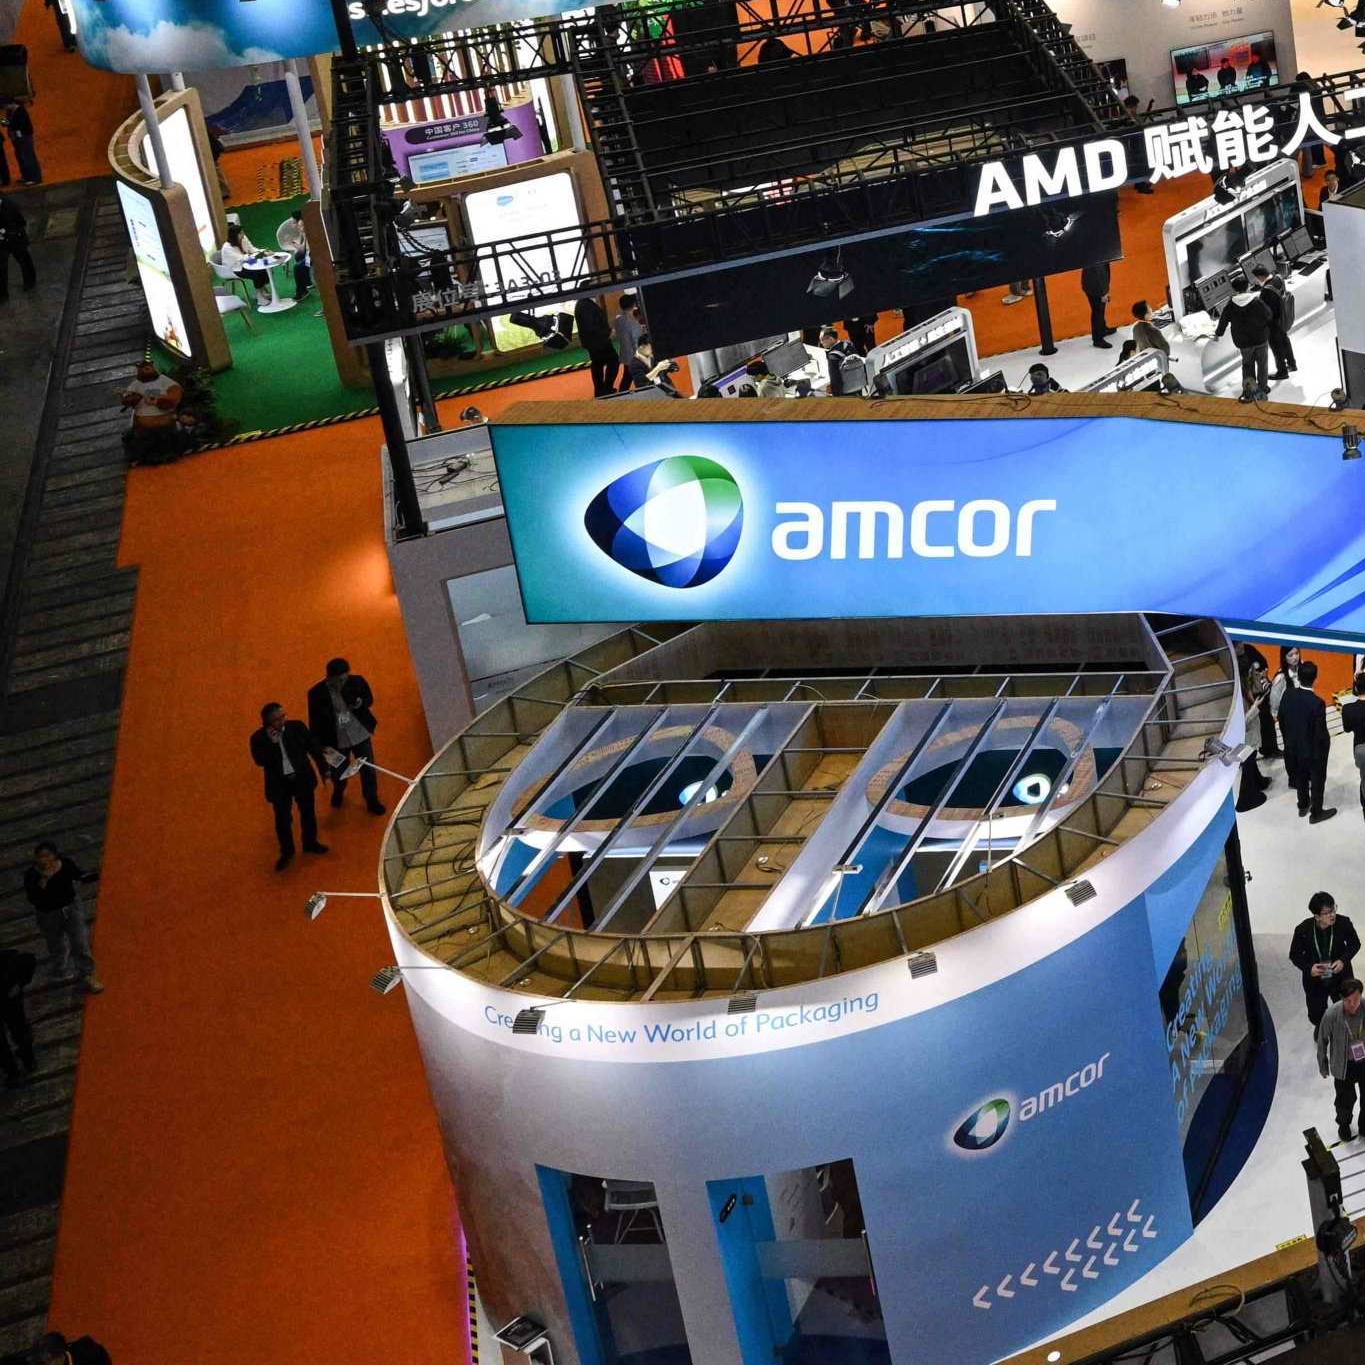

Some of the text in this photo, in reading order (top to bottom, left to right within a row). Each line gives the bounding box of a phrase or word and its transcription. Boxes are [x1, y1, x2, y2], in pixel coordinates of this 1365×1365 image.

[424, 120, 479, 136] 中国客户 360
[973, 138, 1129, 217] AMD
[772, 499, 1057, 561] amcor
[569, 992, 880, 1045] a New World of Packaging
[1019, 1052, 1110, 1122] amcor
